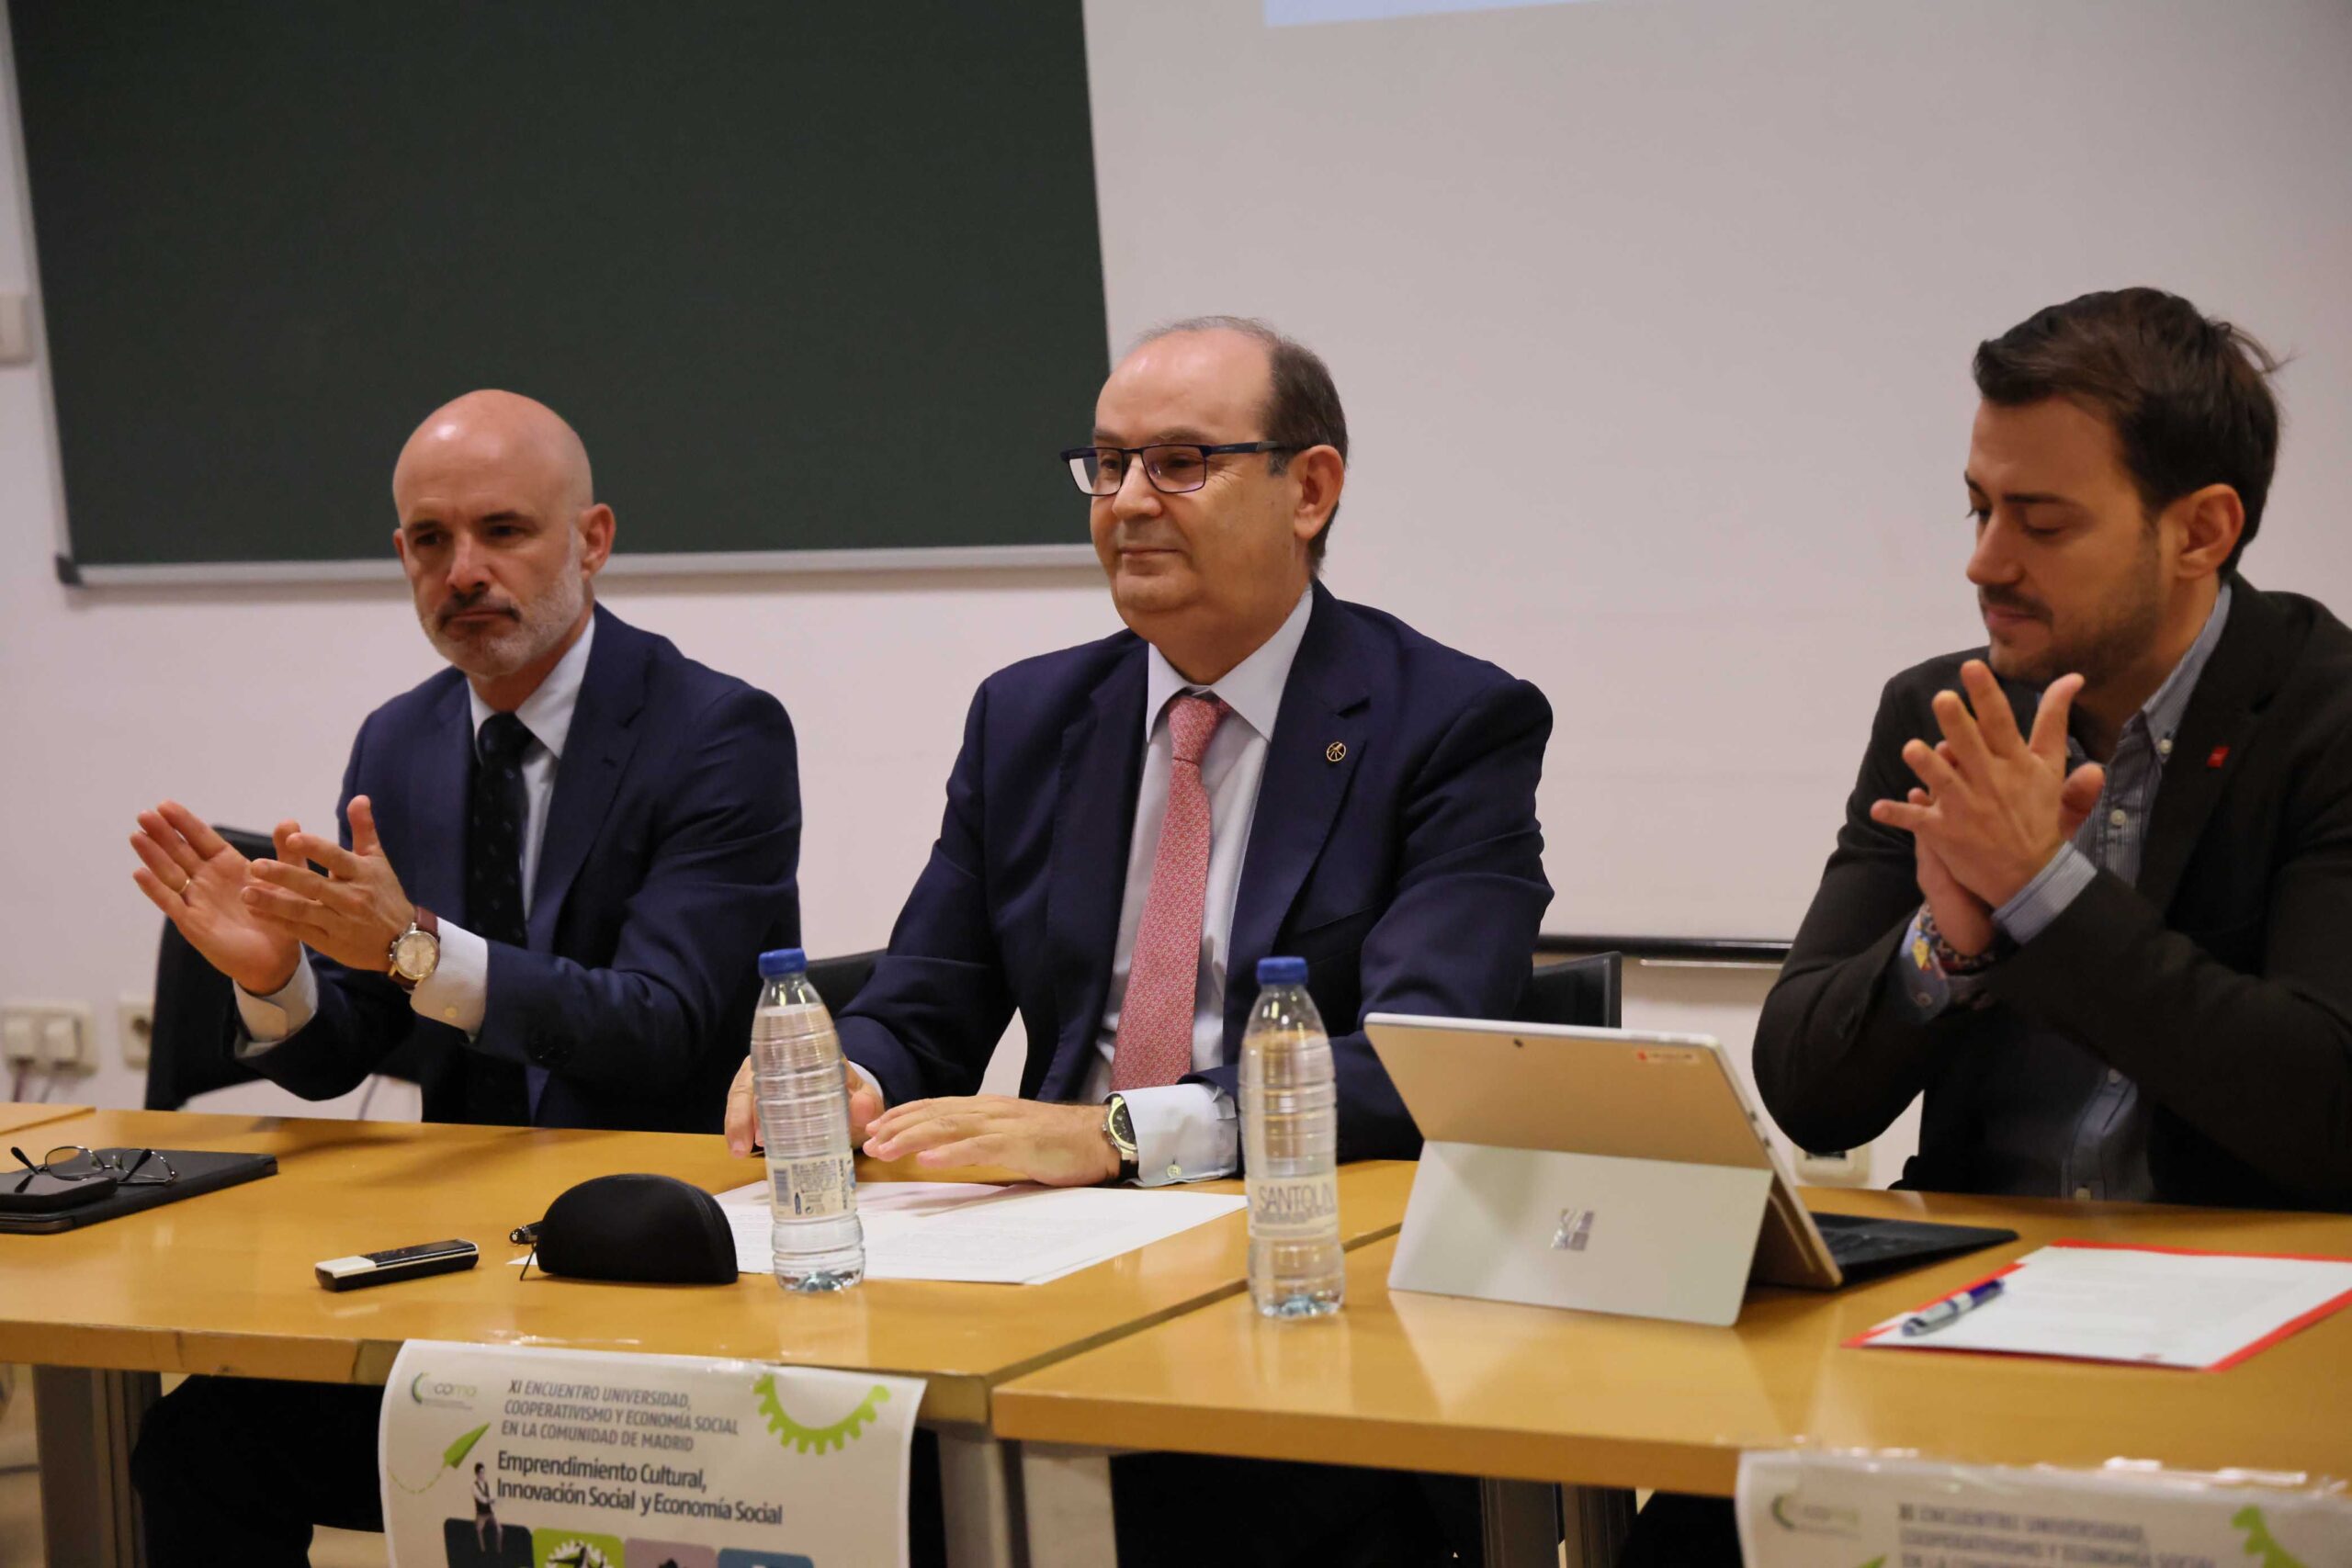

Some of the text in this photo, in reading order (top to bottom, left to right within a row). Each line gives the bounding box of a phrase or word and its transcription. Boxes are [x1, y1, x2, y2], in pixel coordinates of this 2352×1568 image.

[508, 1379, 691, 1412] XI ENCUENTRO UNIVERSIDAD,
[501, 1419, 695, 1453] EN LA COMUNIDAD DE MADRID
[504, 1399, 613, 1424] COOPERATIVISMO
[615, 1408, 625, 1424] Y
[695, 1416, 740, 1437] SOCIAL
[498, 1450, 707, 1495] Emprendimiento Cultural,
[497, 1477, 783, 1525] Innovación Social y Economía Social
